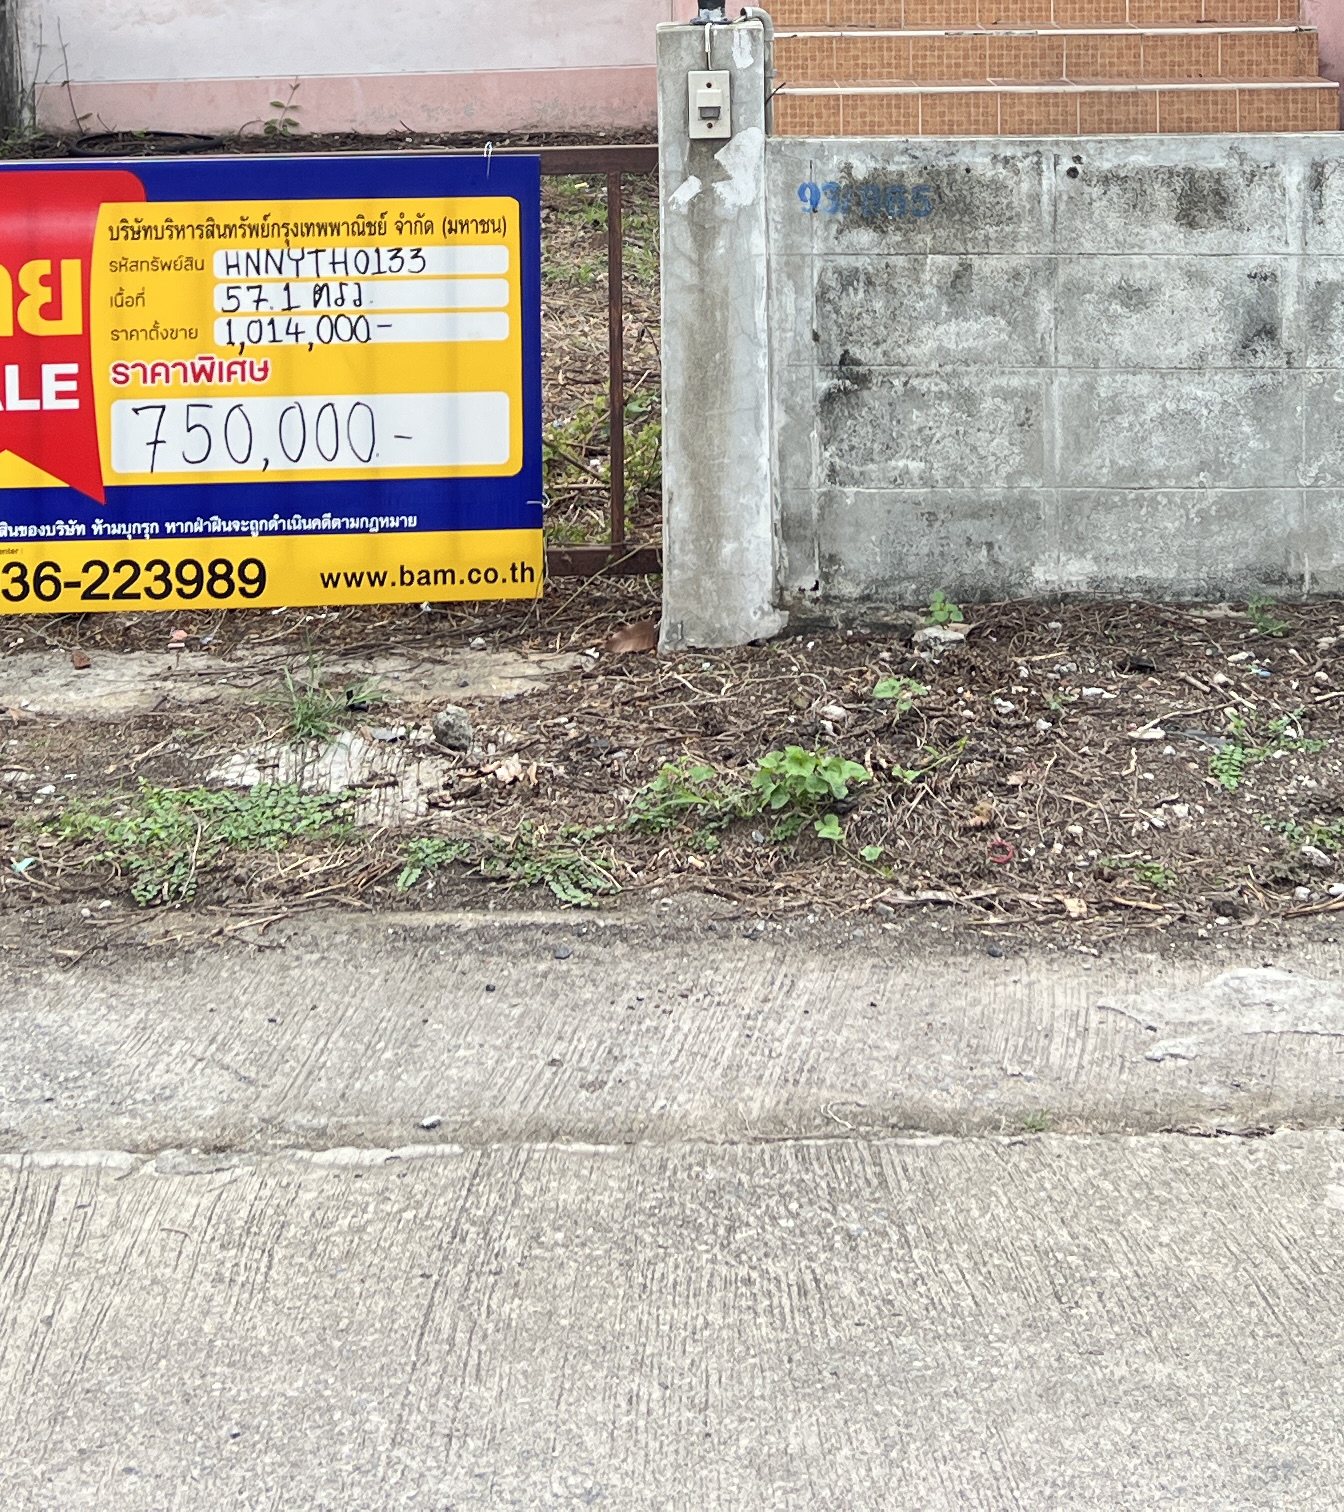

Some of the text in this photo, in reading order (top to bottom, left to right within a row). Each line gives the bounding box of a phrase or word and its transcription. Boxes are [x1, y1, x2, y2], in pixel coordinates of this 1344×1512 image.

[108, 211, 507, 247] บริษัทบริหารสินทรัพย์กรุงเทพพาณิชย์ จำกัด (มหาชน)
[109, 254, 205, 273] รหัสทรัพย์สิน
[109, 286, 146, 308] เนื้อที่
[110, 320, 199, 342] ราคาตั้งขาย
[110, 355, 270, 386] ราคาพิเศษ
[90, 518, 160, 540] ห้ามบุกรุก
[320, 561, 536, 589] www.bam.co.th
